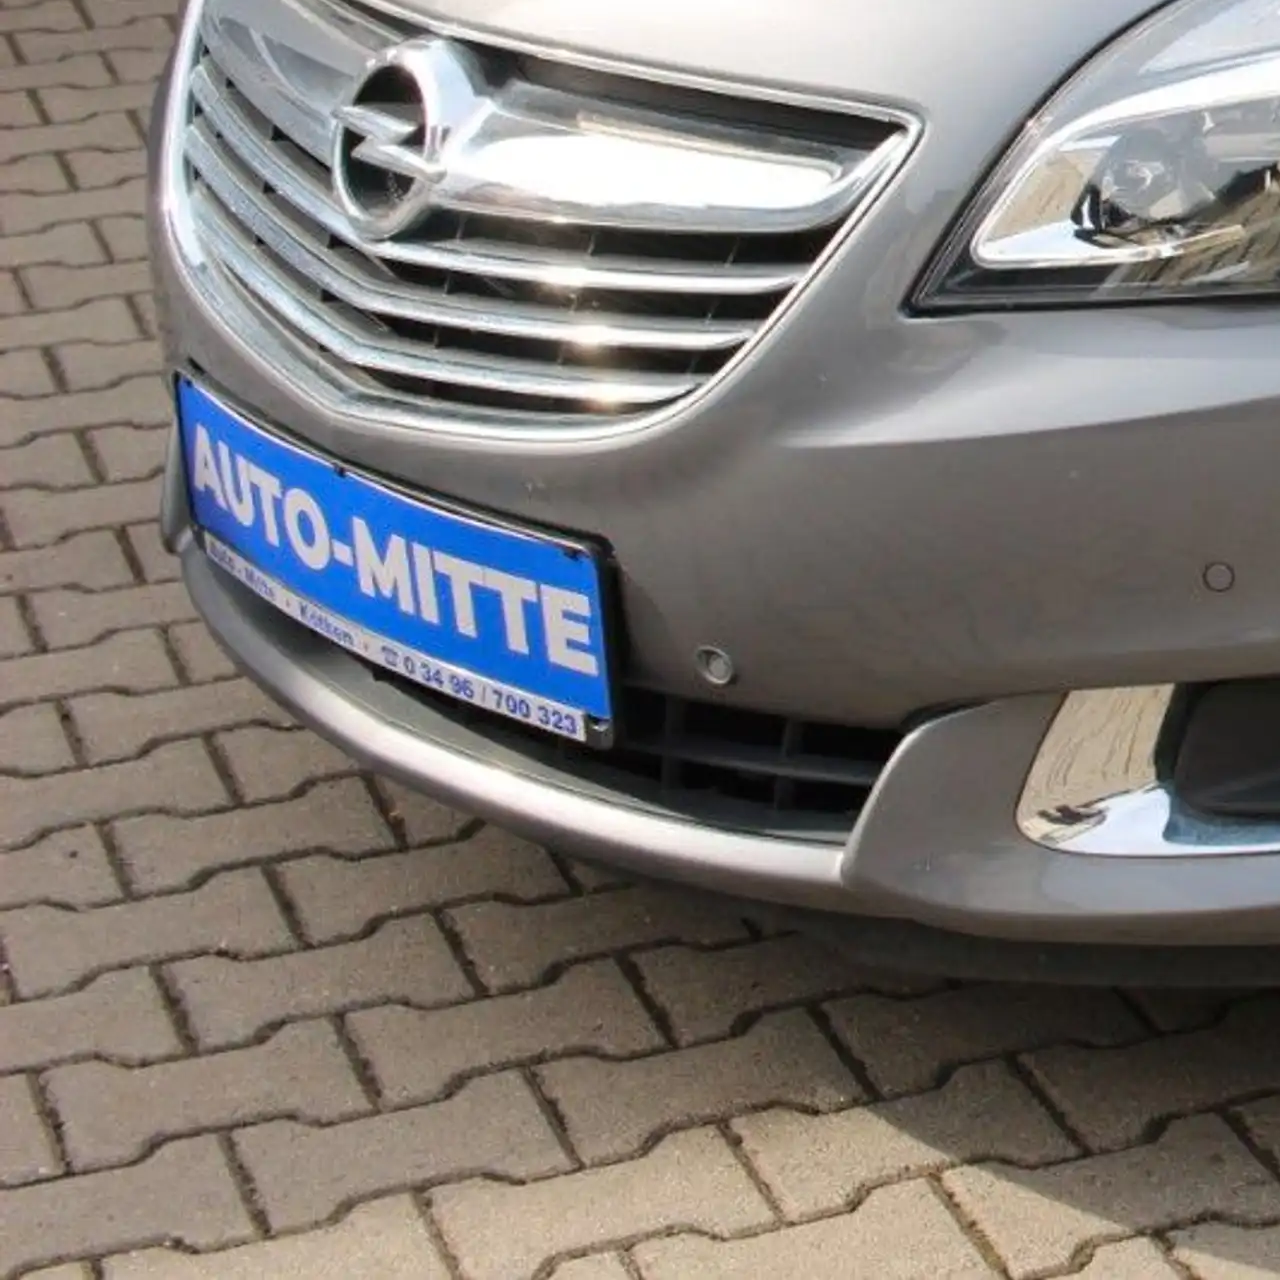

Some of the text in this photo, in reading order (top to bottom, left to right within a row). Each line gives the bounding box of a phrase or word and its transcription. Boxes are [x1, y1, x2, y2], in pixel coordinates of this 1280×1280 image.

[195, 424, 600, 677] AUTO-MITTE
[448, 673, 475, 701] 96
[537, 704, 578, 735] 323
